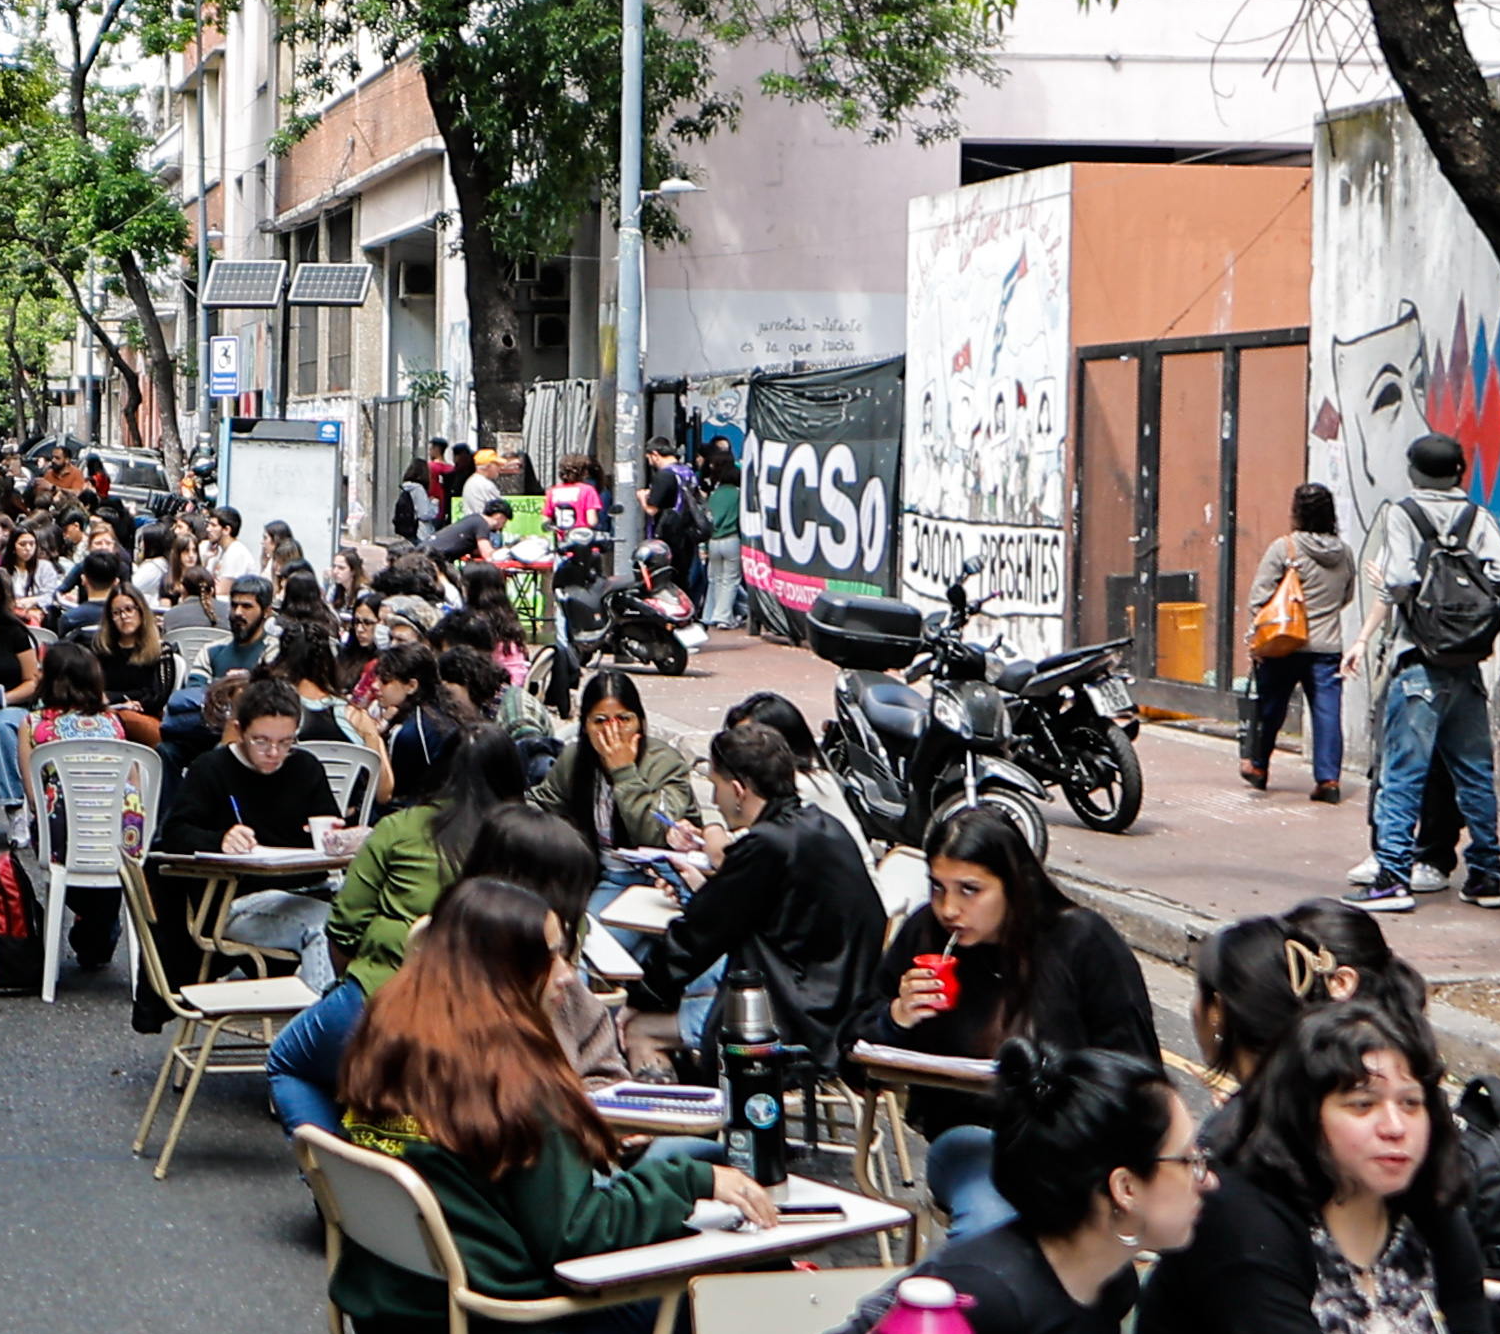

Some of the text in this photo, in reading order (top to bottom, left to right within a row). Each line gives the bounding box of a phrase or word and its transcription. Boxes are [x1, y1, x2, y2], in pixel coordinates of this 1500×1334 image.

[756, 317, 863, 336] juventud militante
[740, 339, 855, 356] es la que lucha
[554, 508, 576, 528] 15
[910, 517, 1060, 606] 30000 PRESENTES
